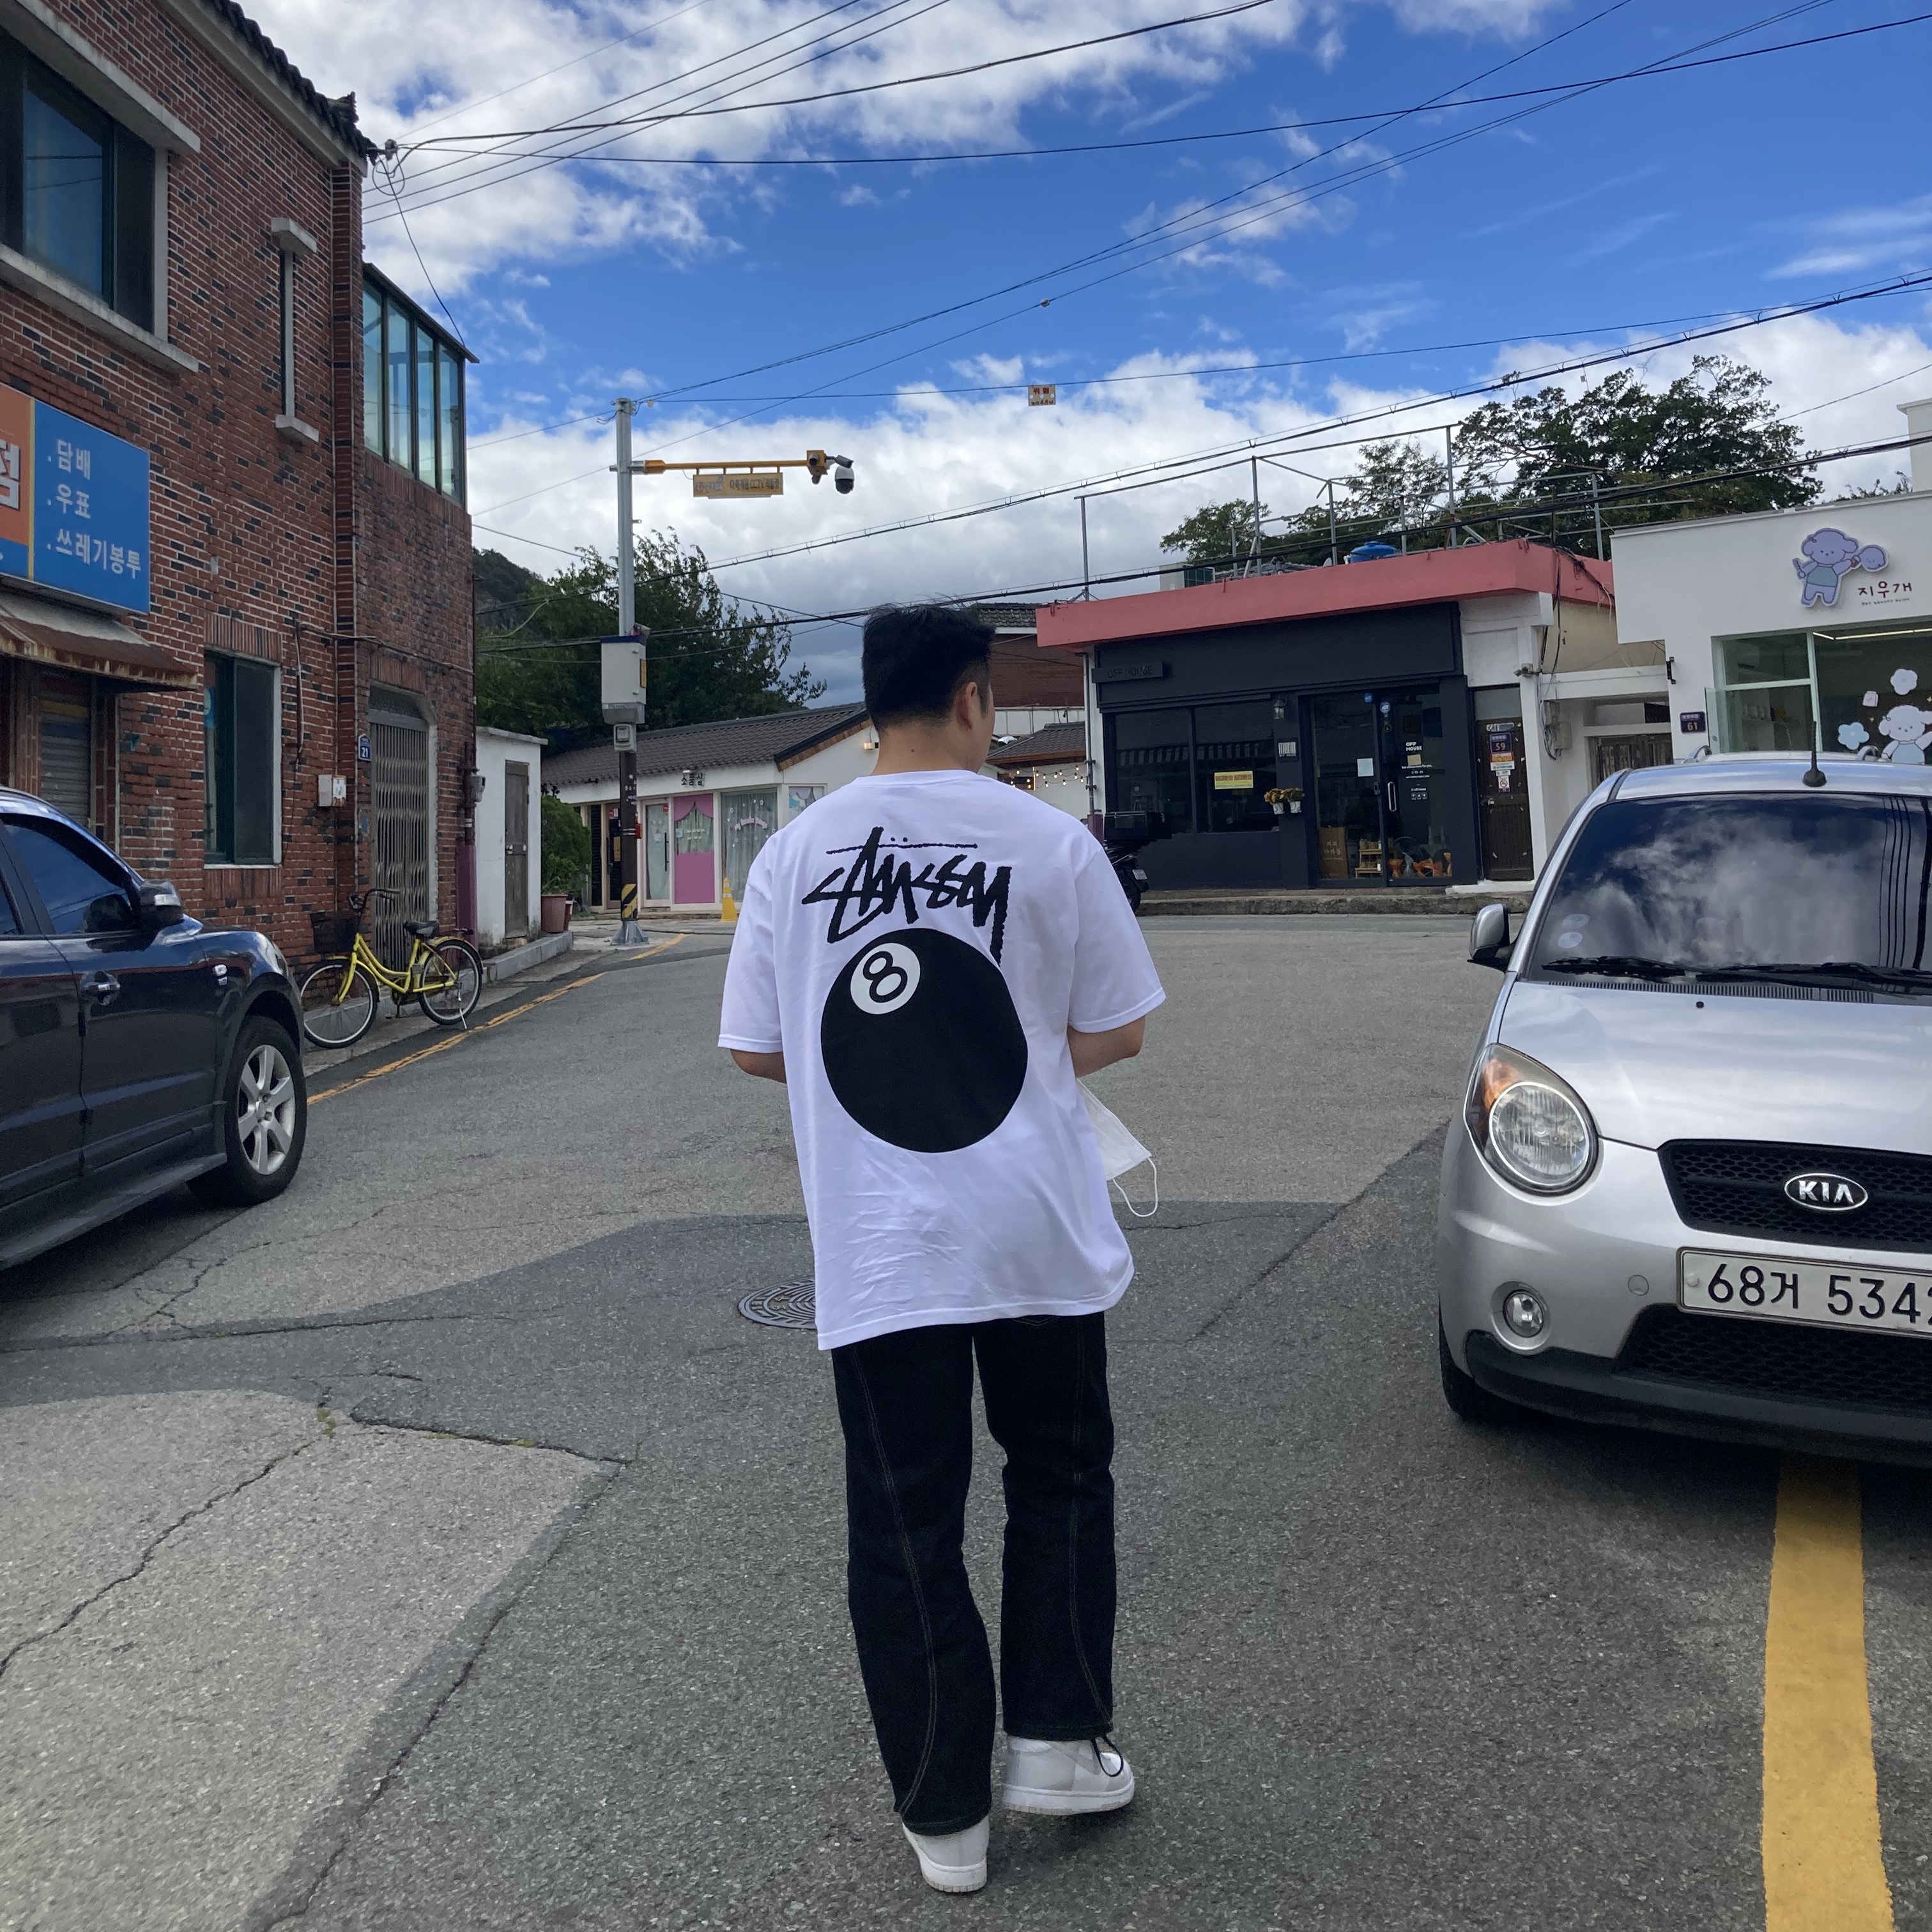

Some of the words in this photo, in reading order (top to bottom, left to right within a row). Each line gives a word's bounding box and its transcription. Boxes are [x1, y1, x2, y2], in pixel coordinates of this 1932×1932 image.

[56, 438, 91, 481] 담배
[55, 484, 91, 519] 우표
[55, 528, 142, 580] 쓰레기봉투
[1858, 581, 1912, 599] 지우개
[1687, 722, 1698, 731] 61
[361, 746, 369, 758] 21
[1495, 742, 1506, 751] 59
[862, 951, 908, 1004] 8
[1798, 1179, 1855, 1204] KIA
[1707, 1262, 1798, 1310] 68거
[1827, 1274, 1932, 1326] 534
